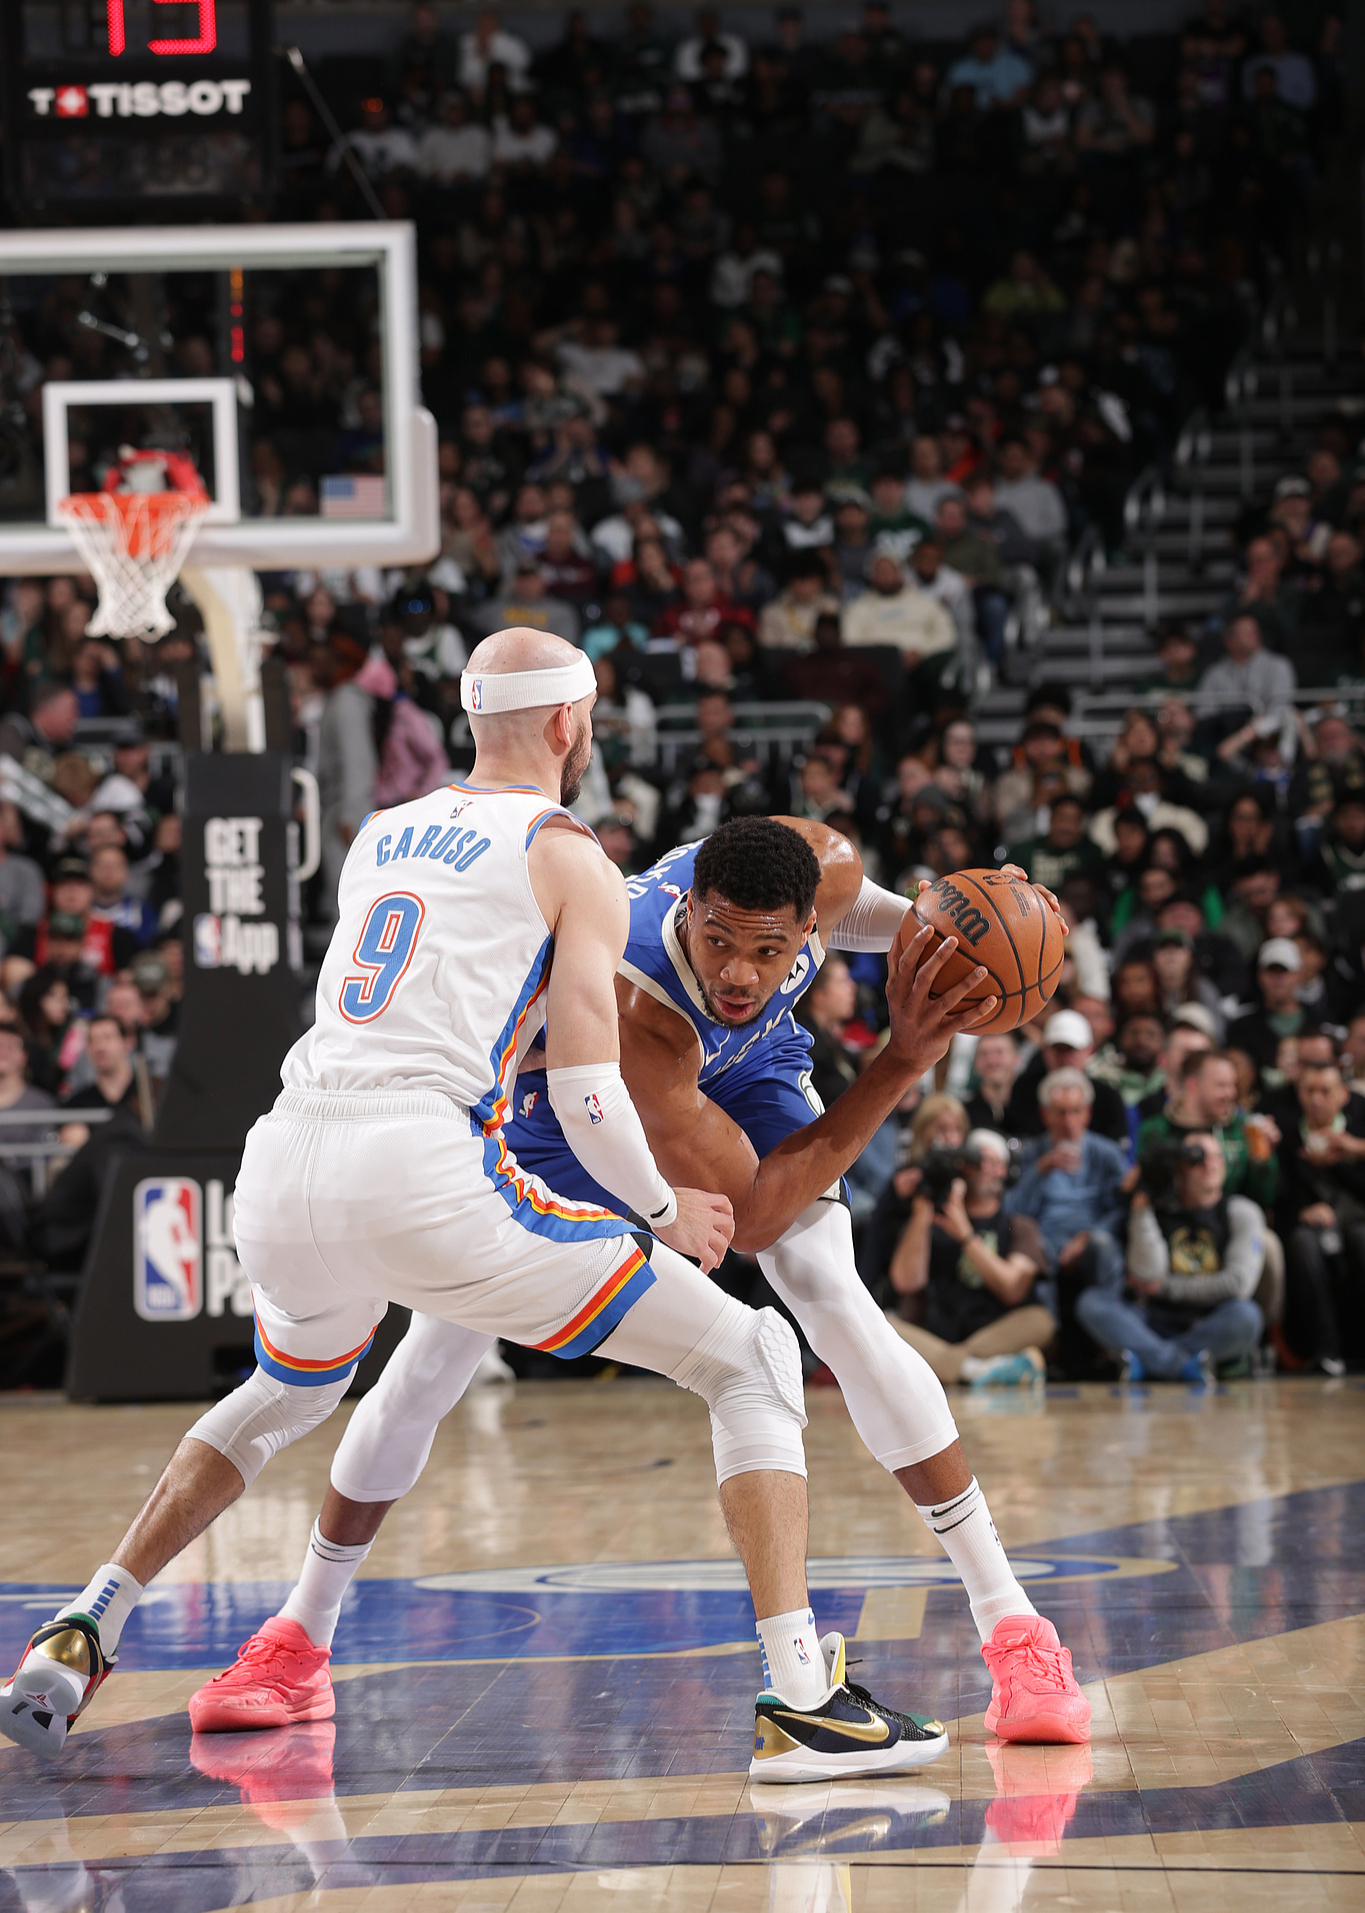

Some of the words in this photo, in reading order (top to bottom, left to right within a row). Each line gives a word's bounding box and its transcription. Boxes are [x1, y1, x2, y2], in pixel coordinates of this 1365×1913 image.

[88, 79, 251, 118] TISSOT
[204, 816, 263, 866] GET
[376, 825, 492, 872] CARUSO
[204, 865, 266, 916] THE
[221, 914, 280, 976] App
[338, 890, 426, 1025] 9
